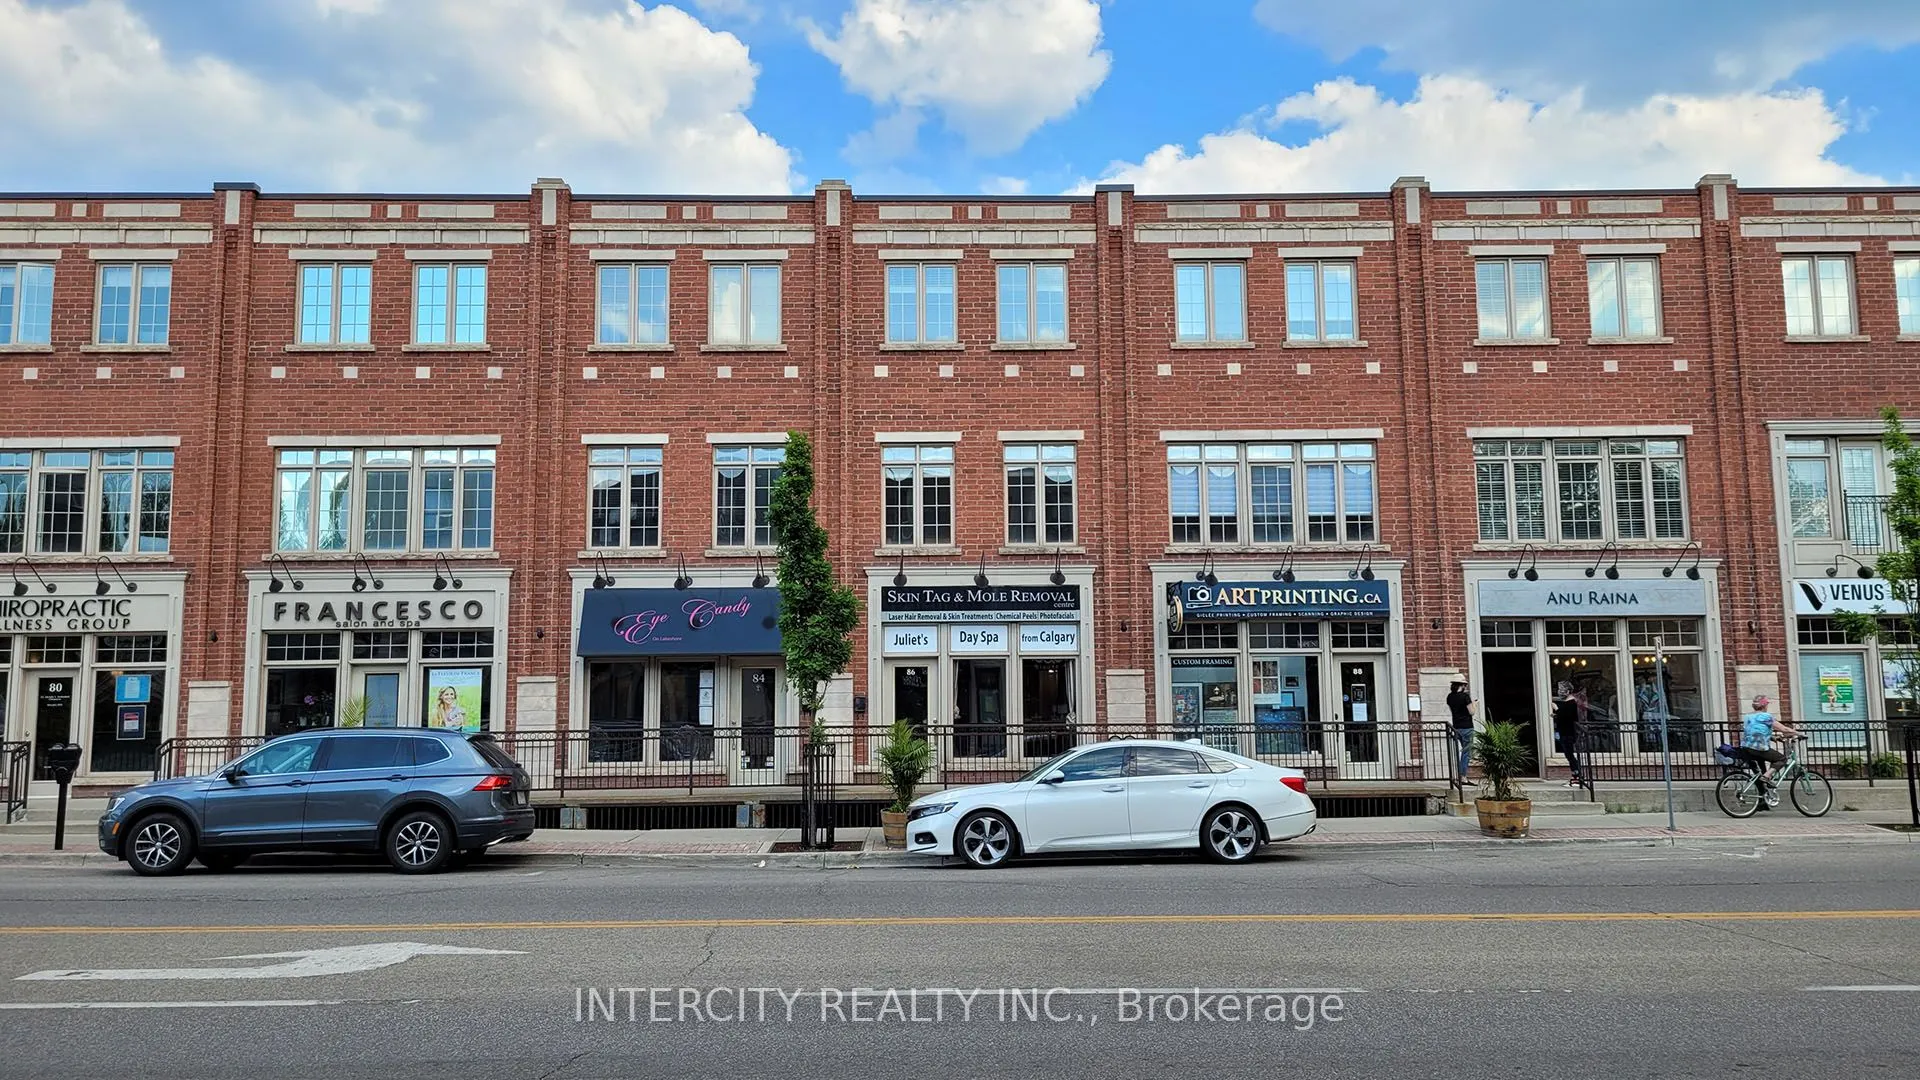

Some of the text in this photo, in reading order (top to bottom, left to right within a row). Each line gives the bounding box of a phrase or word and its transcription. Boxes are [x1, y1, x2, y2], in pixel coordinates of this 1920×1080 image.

[887, 589, 1075, 603] SKIN TAG & MOLE REMOVAL
[1547, 591, 1639, 605] ANU RAINA
[1829, 584, 1885, 600] VENUS
[0, 599, 132, 618] IROPRACTIC
[273, 600, 483, 622] FRANCESCO
[613, 596, 752, 645] Eye Candy
[948, 612, 961, 620] Skin
[961, 612, 994, 620] Treatments
[0, 618, 131, 631] LNESS GROUP
[335, 618, 421, 629] salon and spa
[894, 633, 929, 646] Juliet's
[959, 630, 999, 646] Day Spa
[1022, 631, 1076, 645] from Calgary
[1173, 657, 1233, 666] CUSTOM FRAMING
[752, 673, 766, 683] 84
[49, 682, 63, 692] 80
